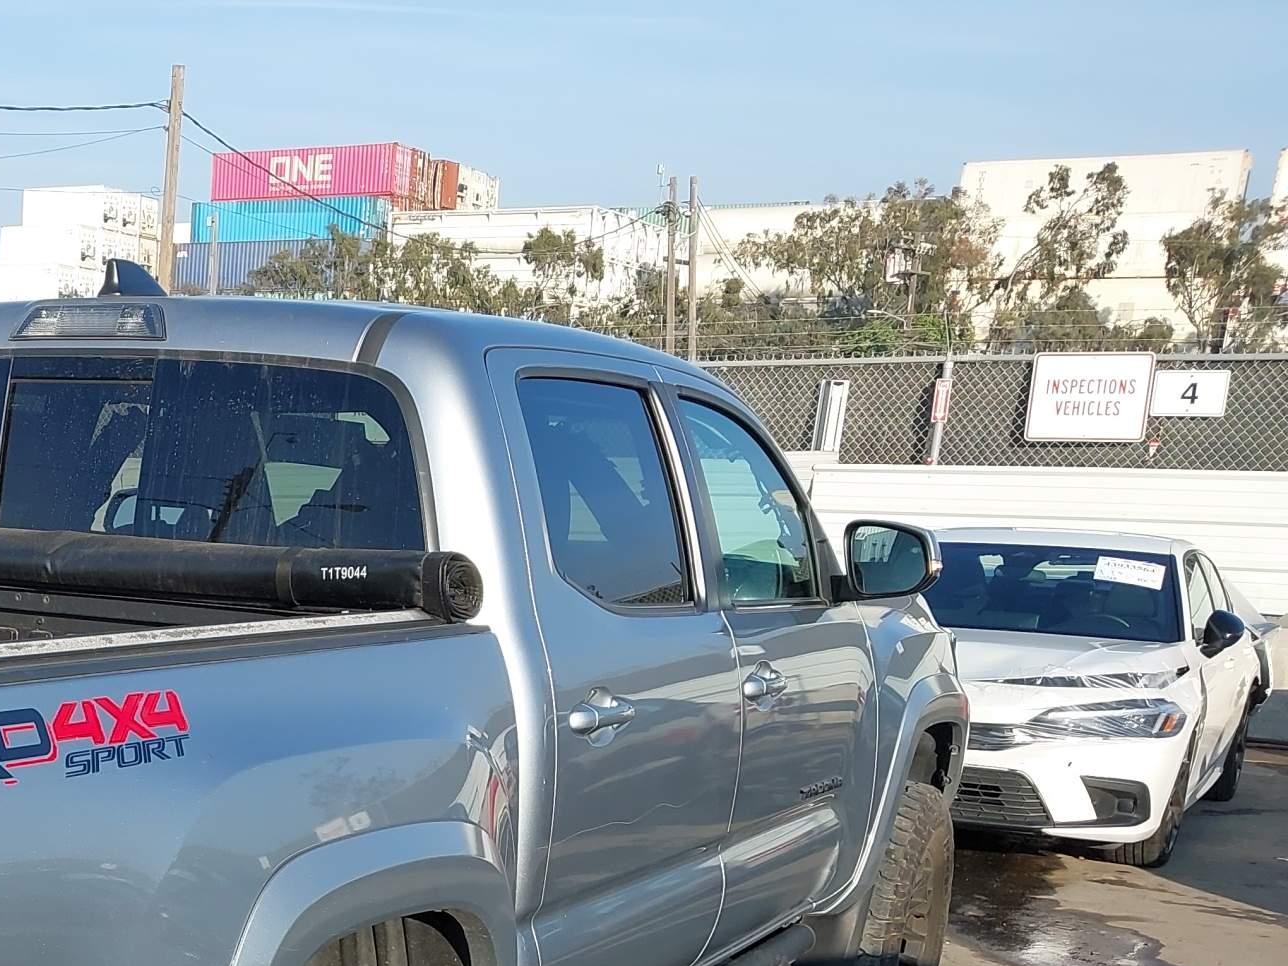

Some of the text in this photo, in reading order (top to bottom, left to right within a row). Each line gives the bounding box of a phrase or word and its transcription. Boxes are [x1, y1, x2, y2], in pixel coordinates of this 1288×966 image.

[269, 153, 333, 184] ONE
[1045, 378, 1137, 395] INSPECTIONS
[1180, 382, 1199, 405] 4
[1055, 400, 1121, 416] VEHICLES
[320, 566, 368, 581] T1T9044
[64, 733, 191, 779] SPORT
